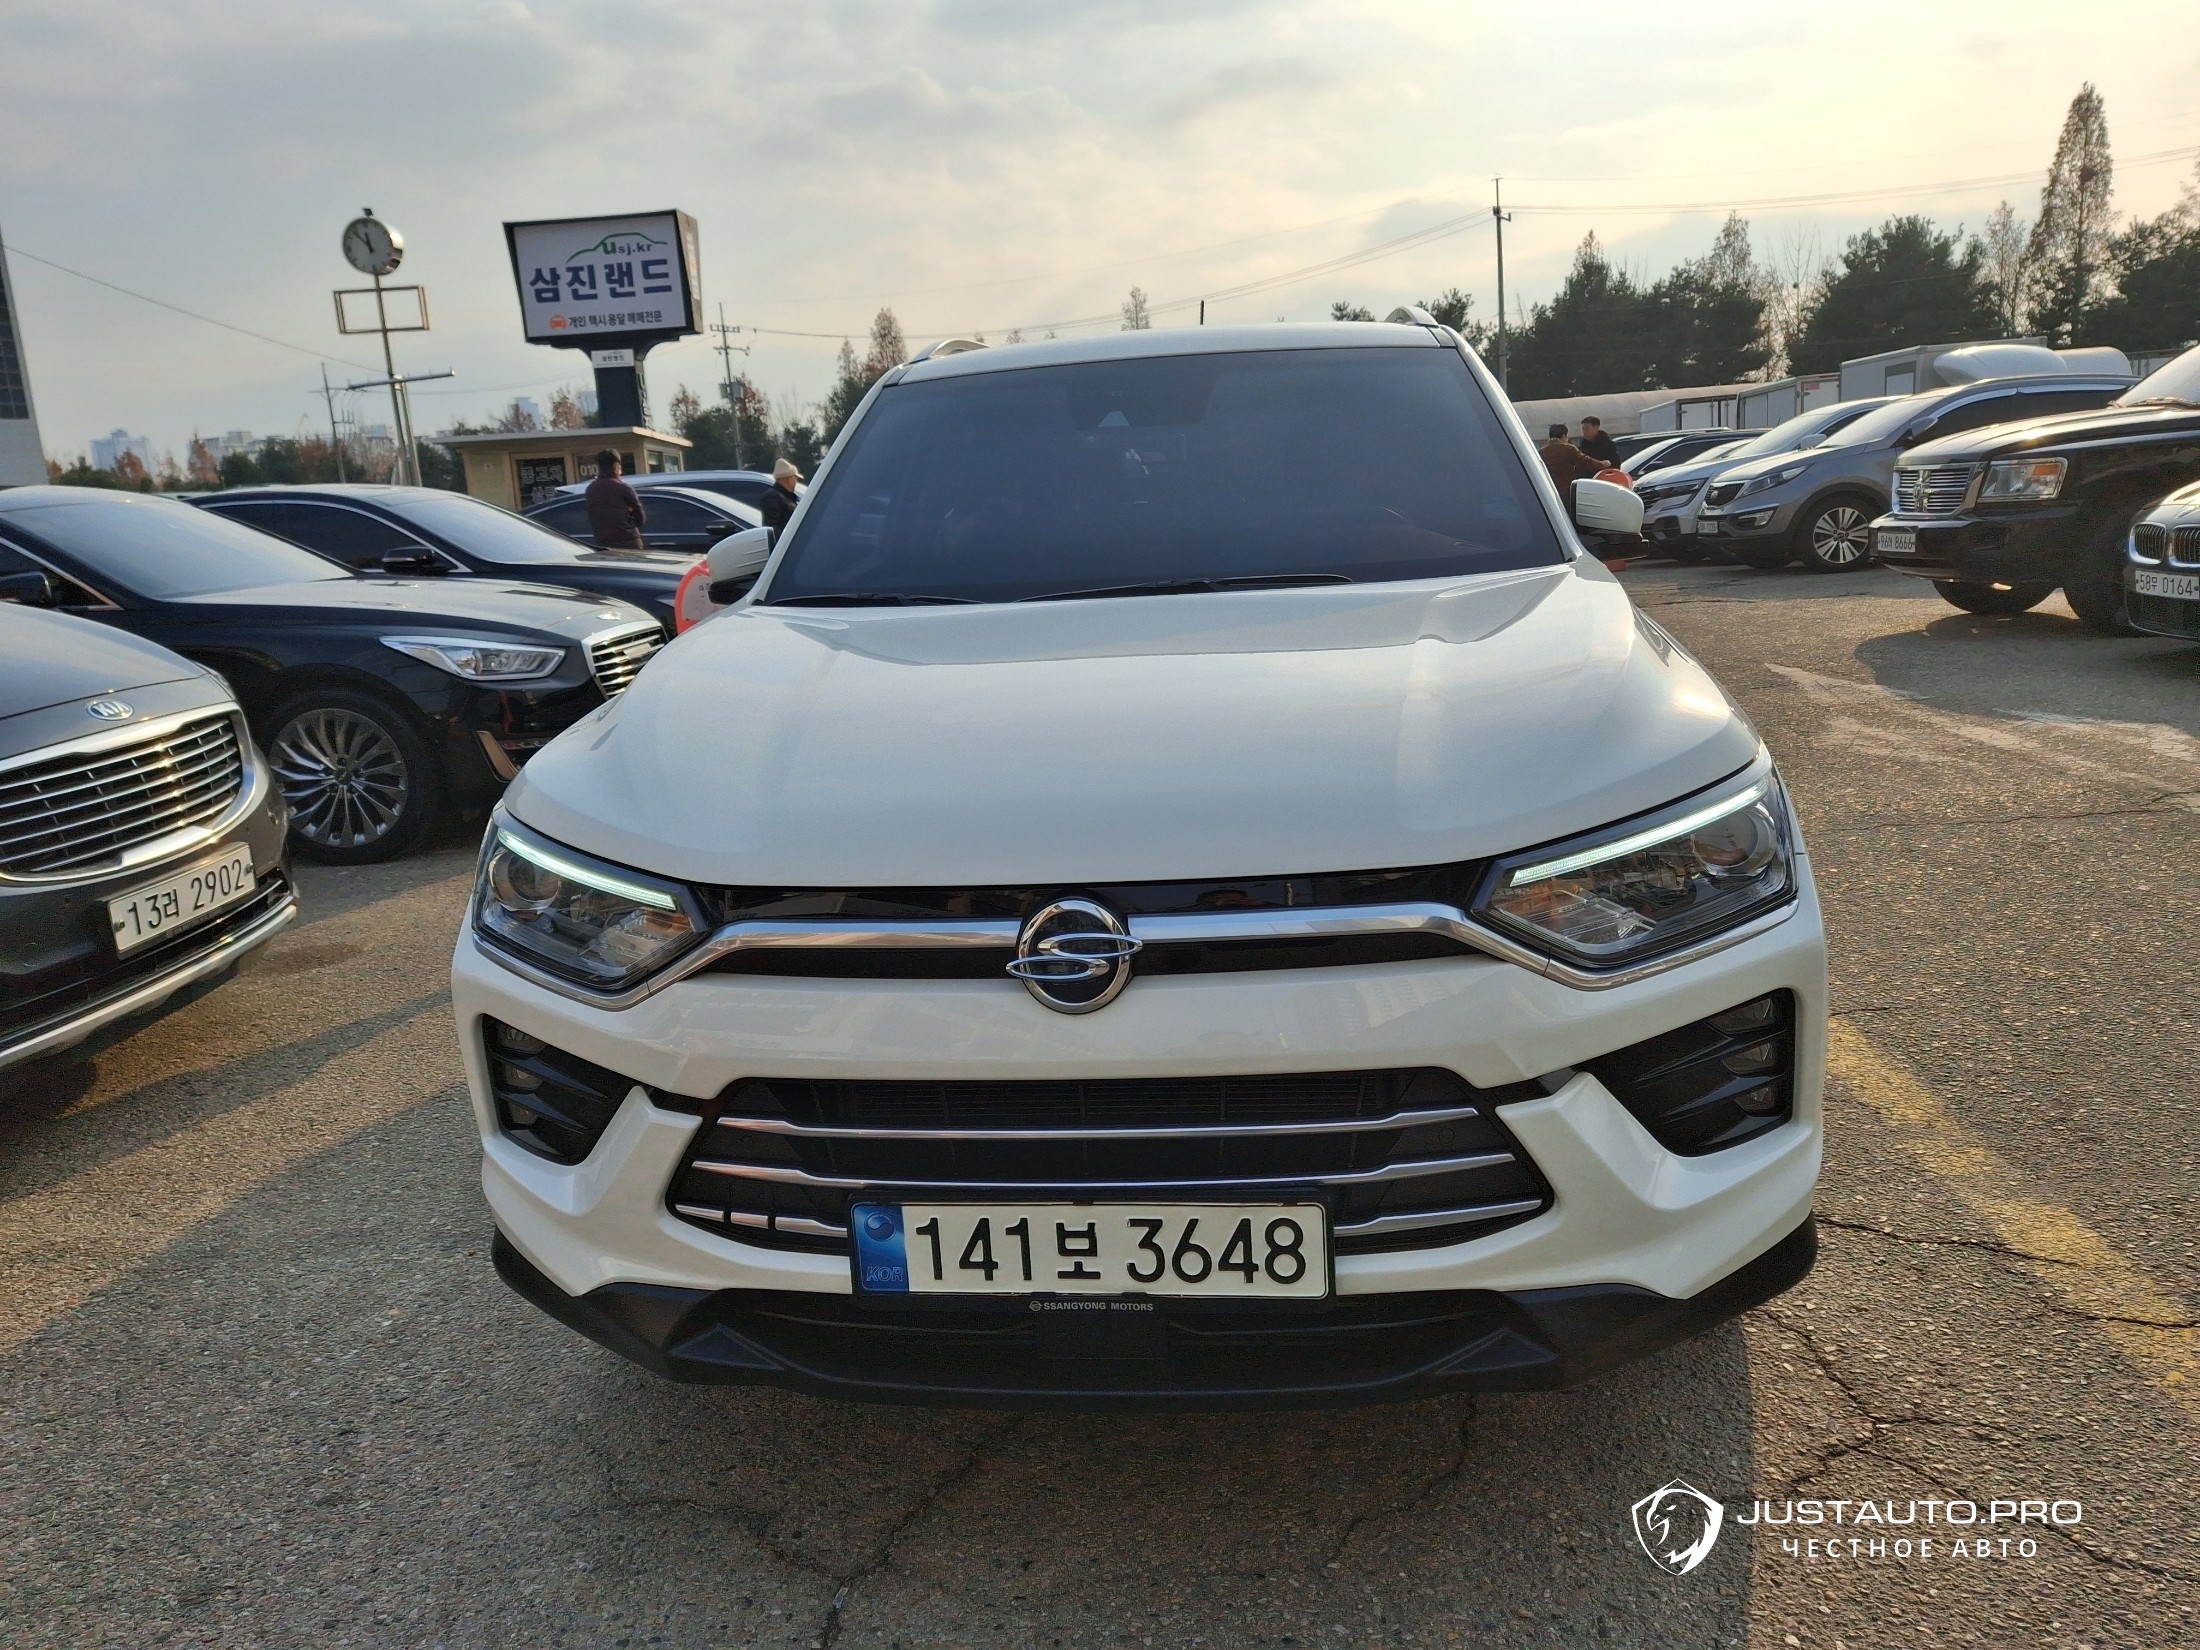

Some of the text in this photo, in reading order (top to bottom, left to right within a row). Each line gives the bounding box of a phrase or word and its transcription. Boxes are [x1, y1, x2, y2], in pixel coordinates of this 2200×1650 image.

[602, 242, 653, 256] usj.kr
[529, 258, 673, 304] 삼진랜드
[568, 315, 587, 328] 개인
[2162, 576, 2193, 596] 0164
[92, 701, 131, 717] KIA
[127, 888, 180, 936] 13러
[190, 858, 246, 911] 2902
[1126, 1216, 1307, 1284] 3648
[866, 1265, 904, 1282] KOR
[1043, 1301, 1154, 1312] SSANGYONG MOTORS
